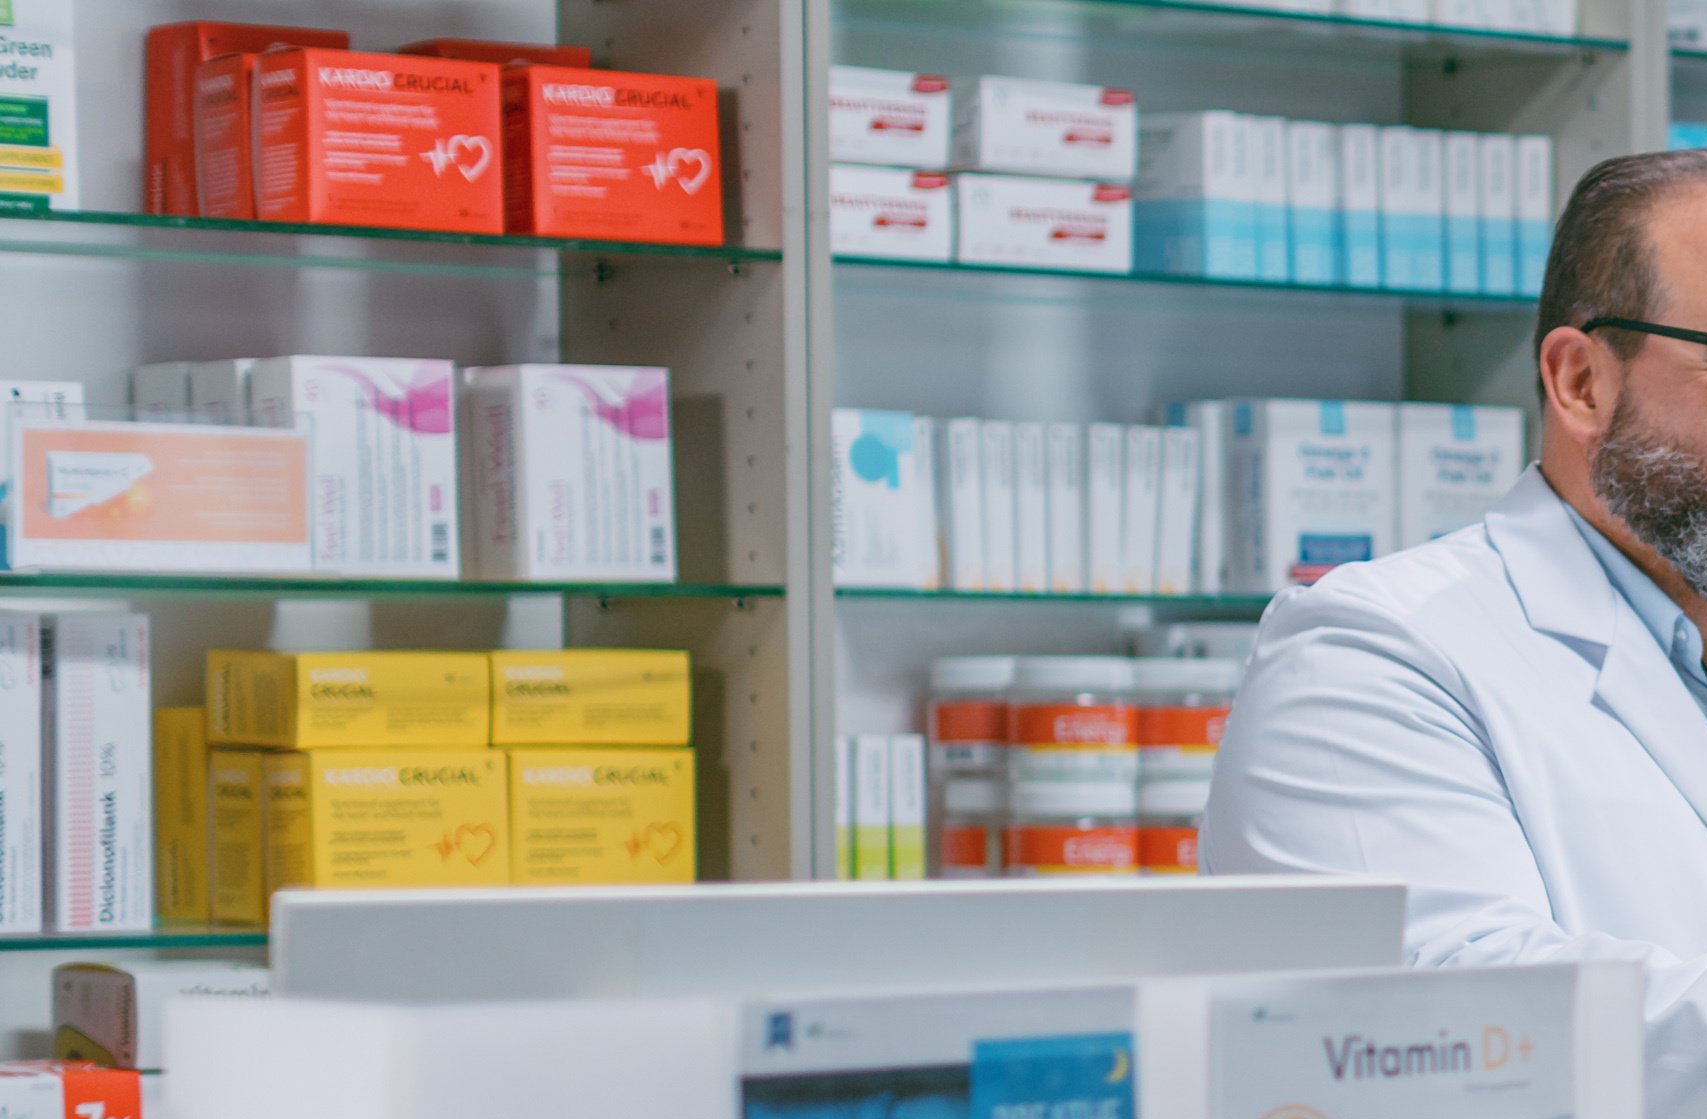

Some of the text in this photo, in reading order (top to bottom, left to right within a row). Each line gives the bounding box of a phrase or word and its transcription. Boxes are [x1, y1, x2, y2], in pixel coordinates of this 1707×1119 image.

[0, 61, 38, 80] der
[394, 73, 474, 94] CRUCIAL
[615, 88, 691, 109] CRUCIAL
[101, 742, 116, 777] 10%
[399, 767, 480, 786] CRUCIAL
[592, 766, 668, 786] CRUCIAL
[1322, 1029, 1471, 1082] Vitamin
